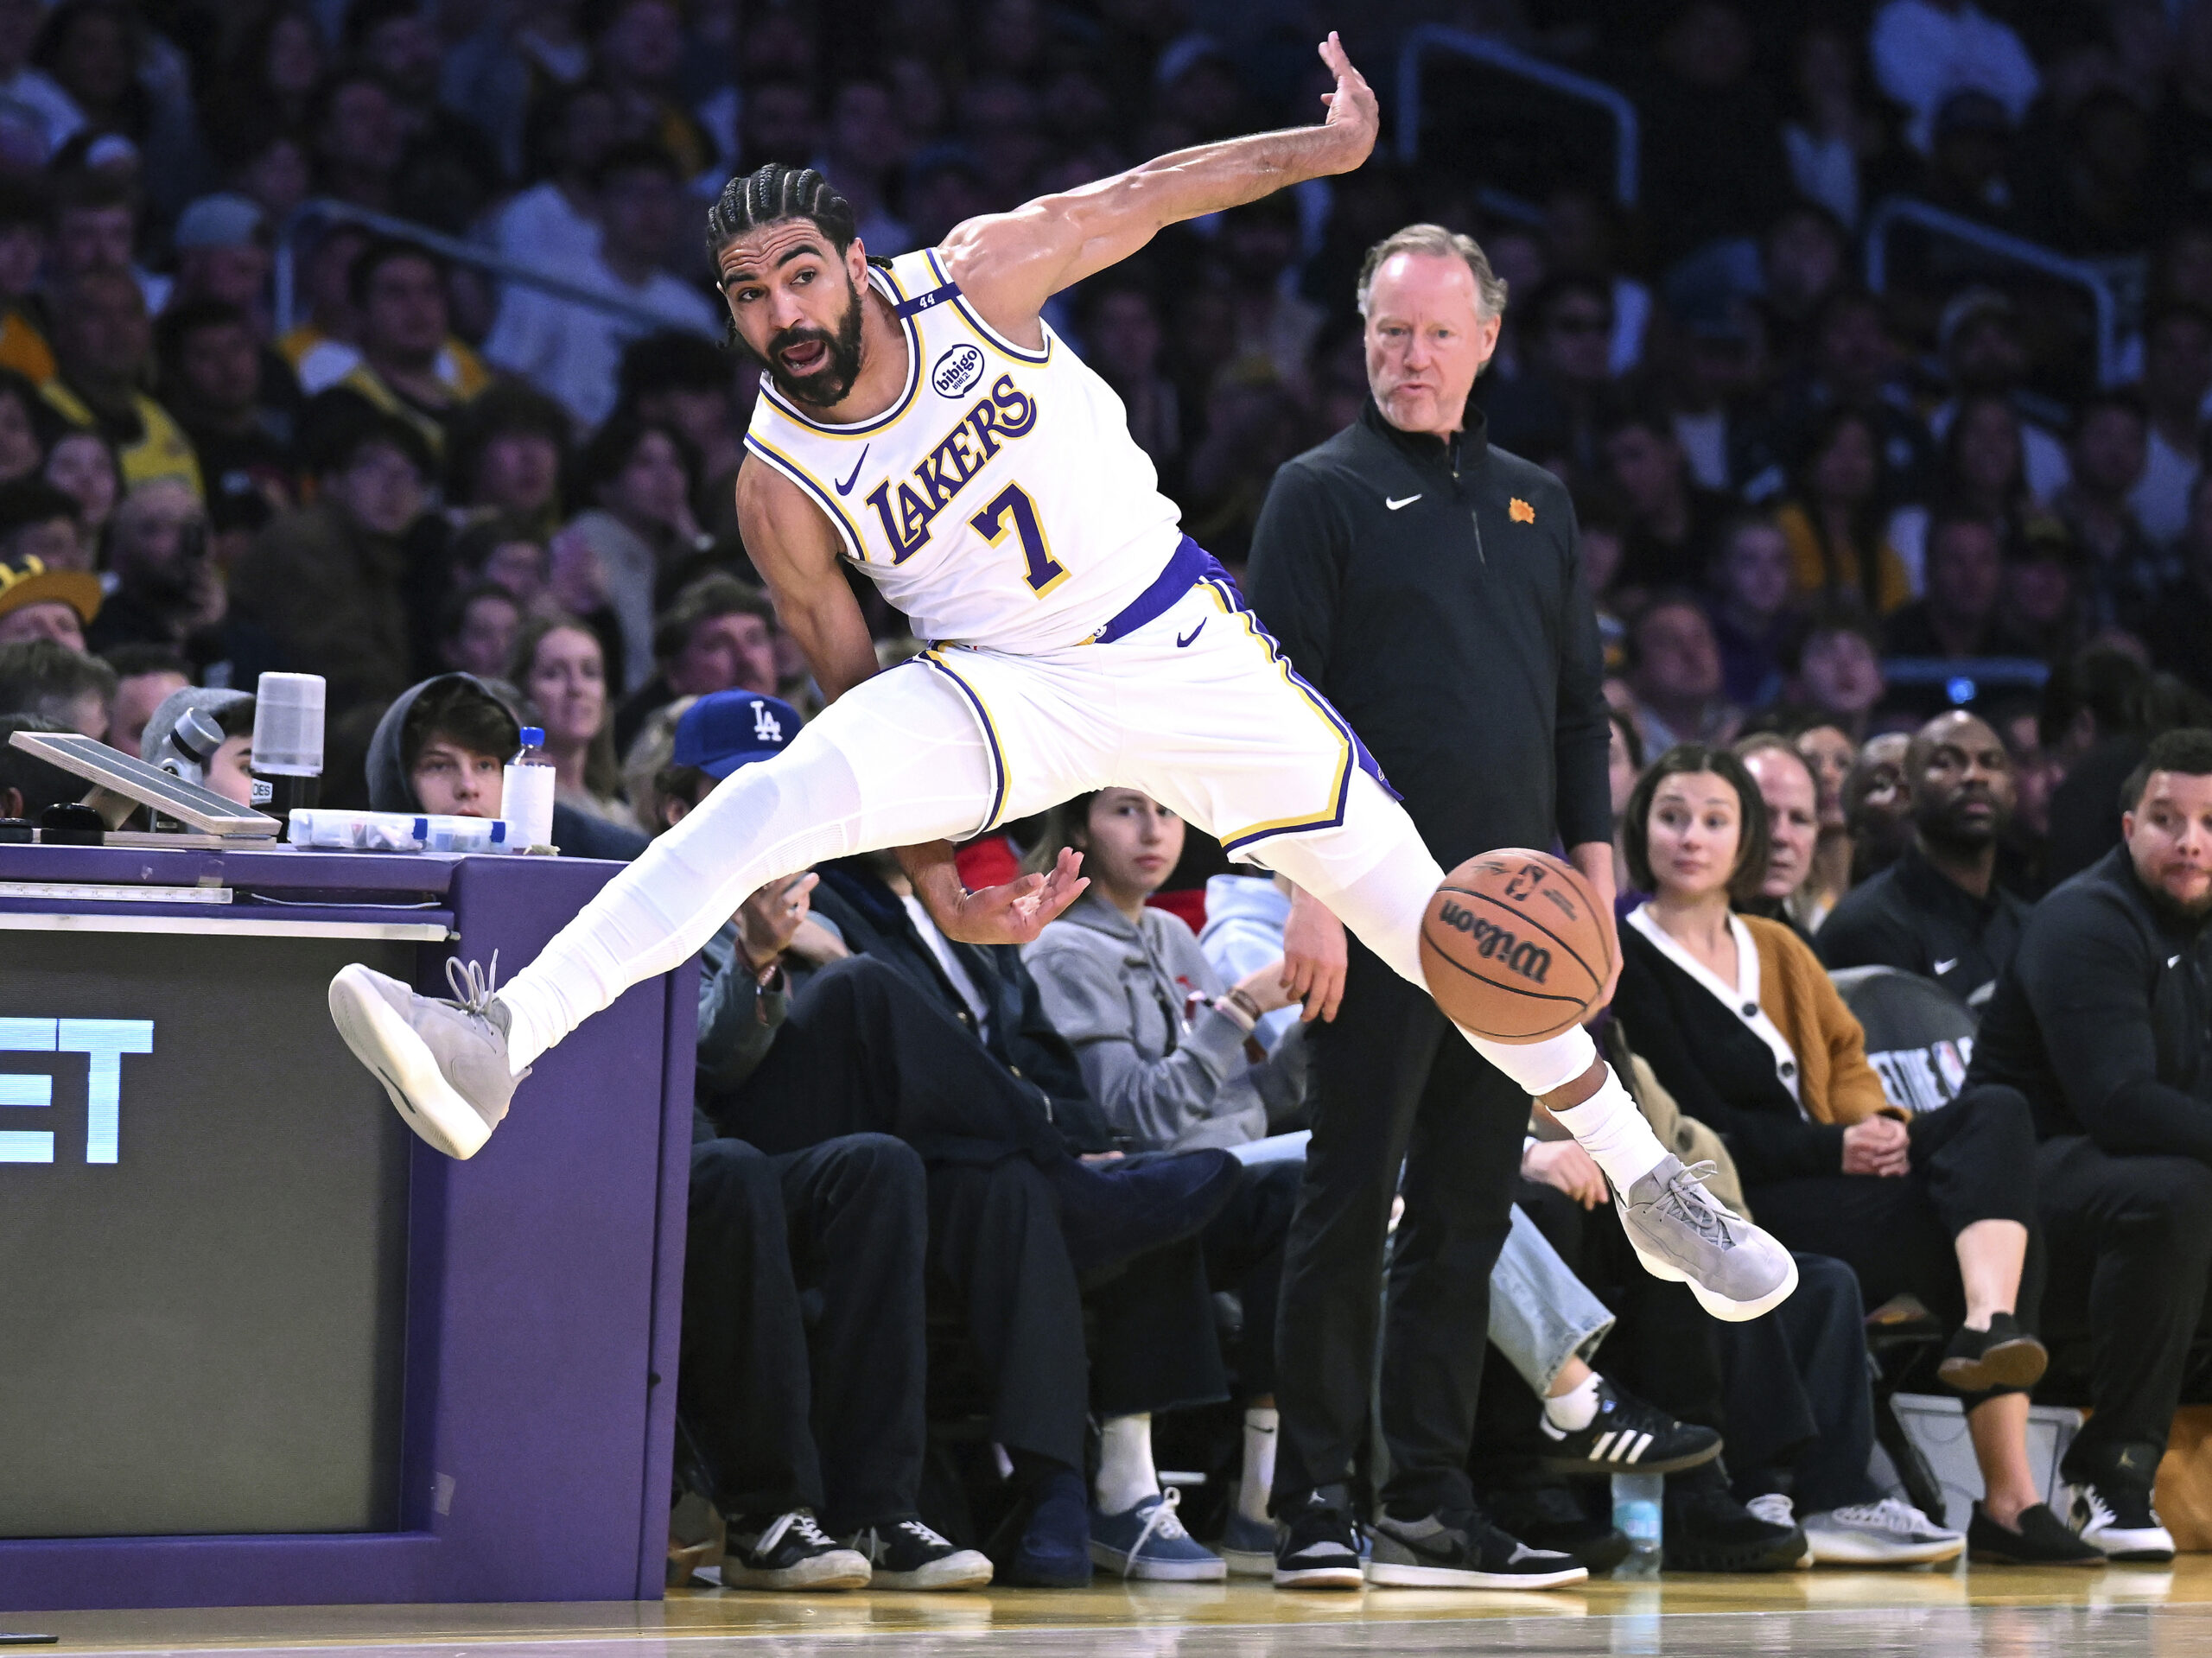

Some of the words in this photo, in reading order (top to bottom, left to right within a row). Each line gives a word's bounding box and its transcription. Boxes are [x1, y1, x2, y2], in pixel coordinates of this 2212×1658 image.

[919, 293, 936, 308] 44
[936, 350, 977, 391] bibigo
[951, 372, 970, 391] 비비고
[863, 372, 1038, 566] LAKERS
[965, 480, 1072, 600] 7
[750, 700, 783, 742] LA
[1438, 899, 1553, 985] Wilson
